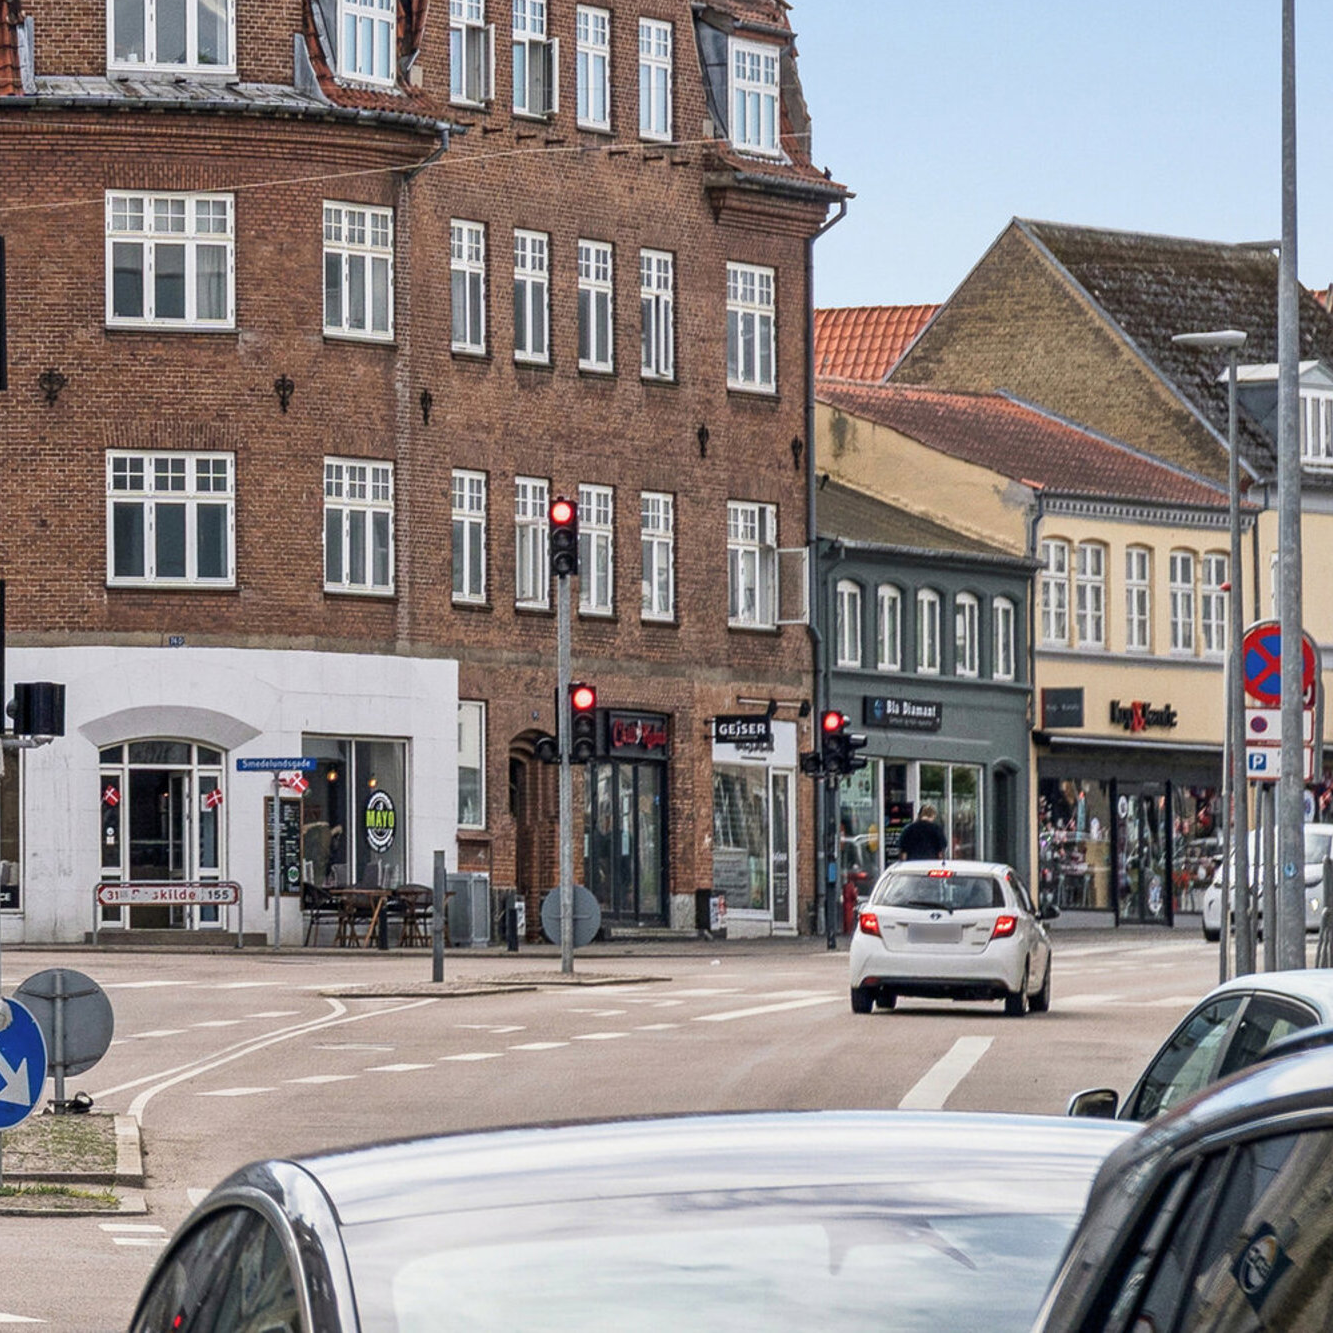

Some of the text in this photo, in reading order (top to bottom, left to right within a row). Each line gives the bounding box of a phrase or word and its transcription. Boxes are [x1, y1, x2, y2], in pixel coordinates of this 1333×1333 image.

[1253, 755, 1264, 770] P
[366, 810, 395, 828] MAYO
[107, 890, 119, 900] 31
[208, 890, 229, 900] 155
